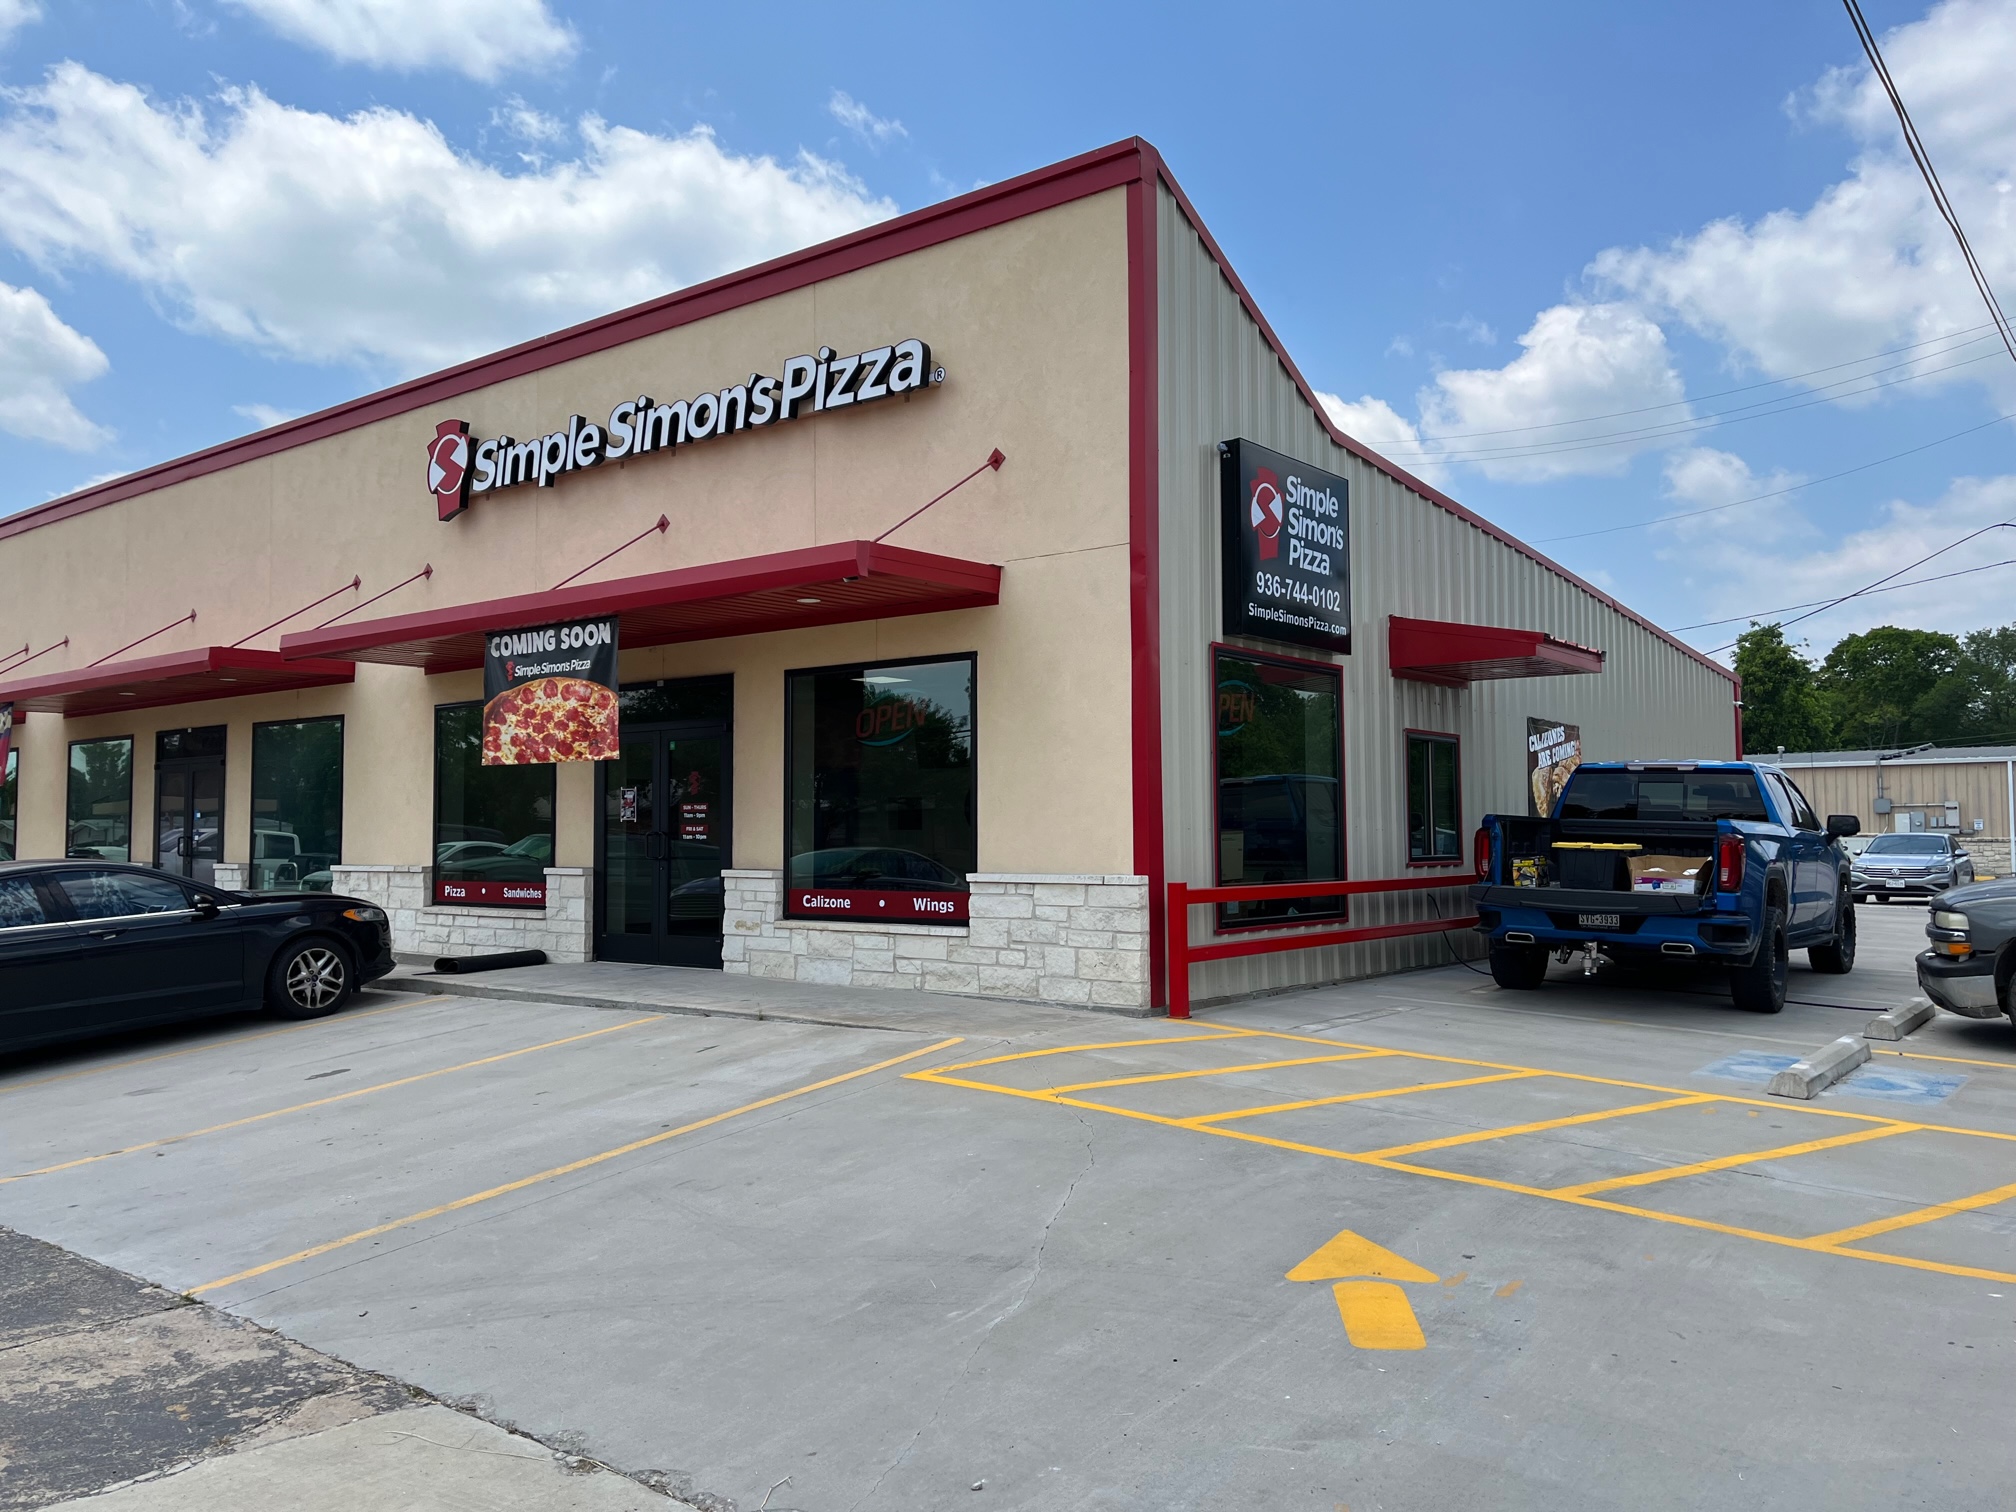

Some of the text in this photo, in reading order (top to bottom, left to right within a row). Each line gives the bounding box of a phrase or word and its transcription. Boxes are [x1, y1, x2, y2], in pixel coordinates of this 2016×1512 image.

[472, 414, 602, 492] Simple
[606, 373, 779, 458] Simon's
[780, 338, 931, 420] Pizza
[1285, 475, 1339, 518] Simple
[1287, 507, 1344, 550] Simon's
[1288, 538, 1330, 576] Pizza
[1256, 571, 1341, 612] 936-744-0102
[1248, 602, 1347, 636] SimpleSimonsPizza.com
[490, 622, 611, 658] COMING SOON
[514, 659, 591, 677] Simple Simon's Pizza
[855, 701, 926, 738] OPEN
[1219, 693, 1255, 723] PEN
[1538, 749, 1552, 769] ARE
[444, 885, 542, 899] Pizza Sandwiches
[802, 894, 955, 913] Calizone Wings
